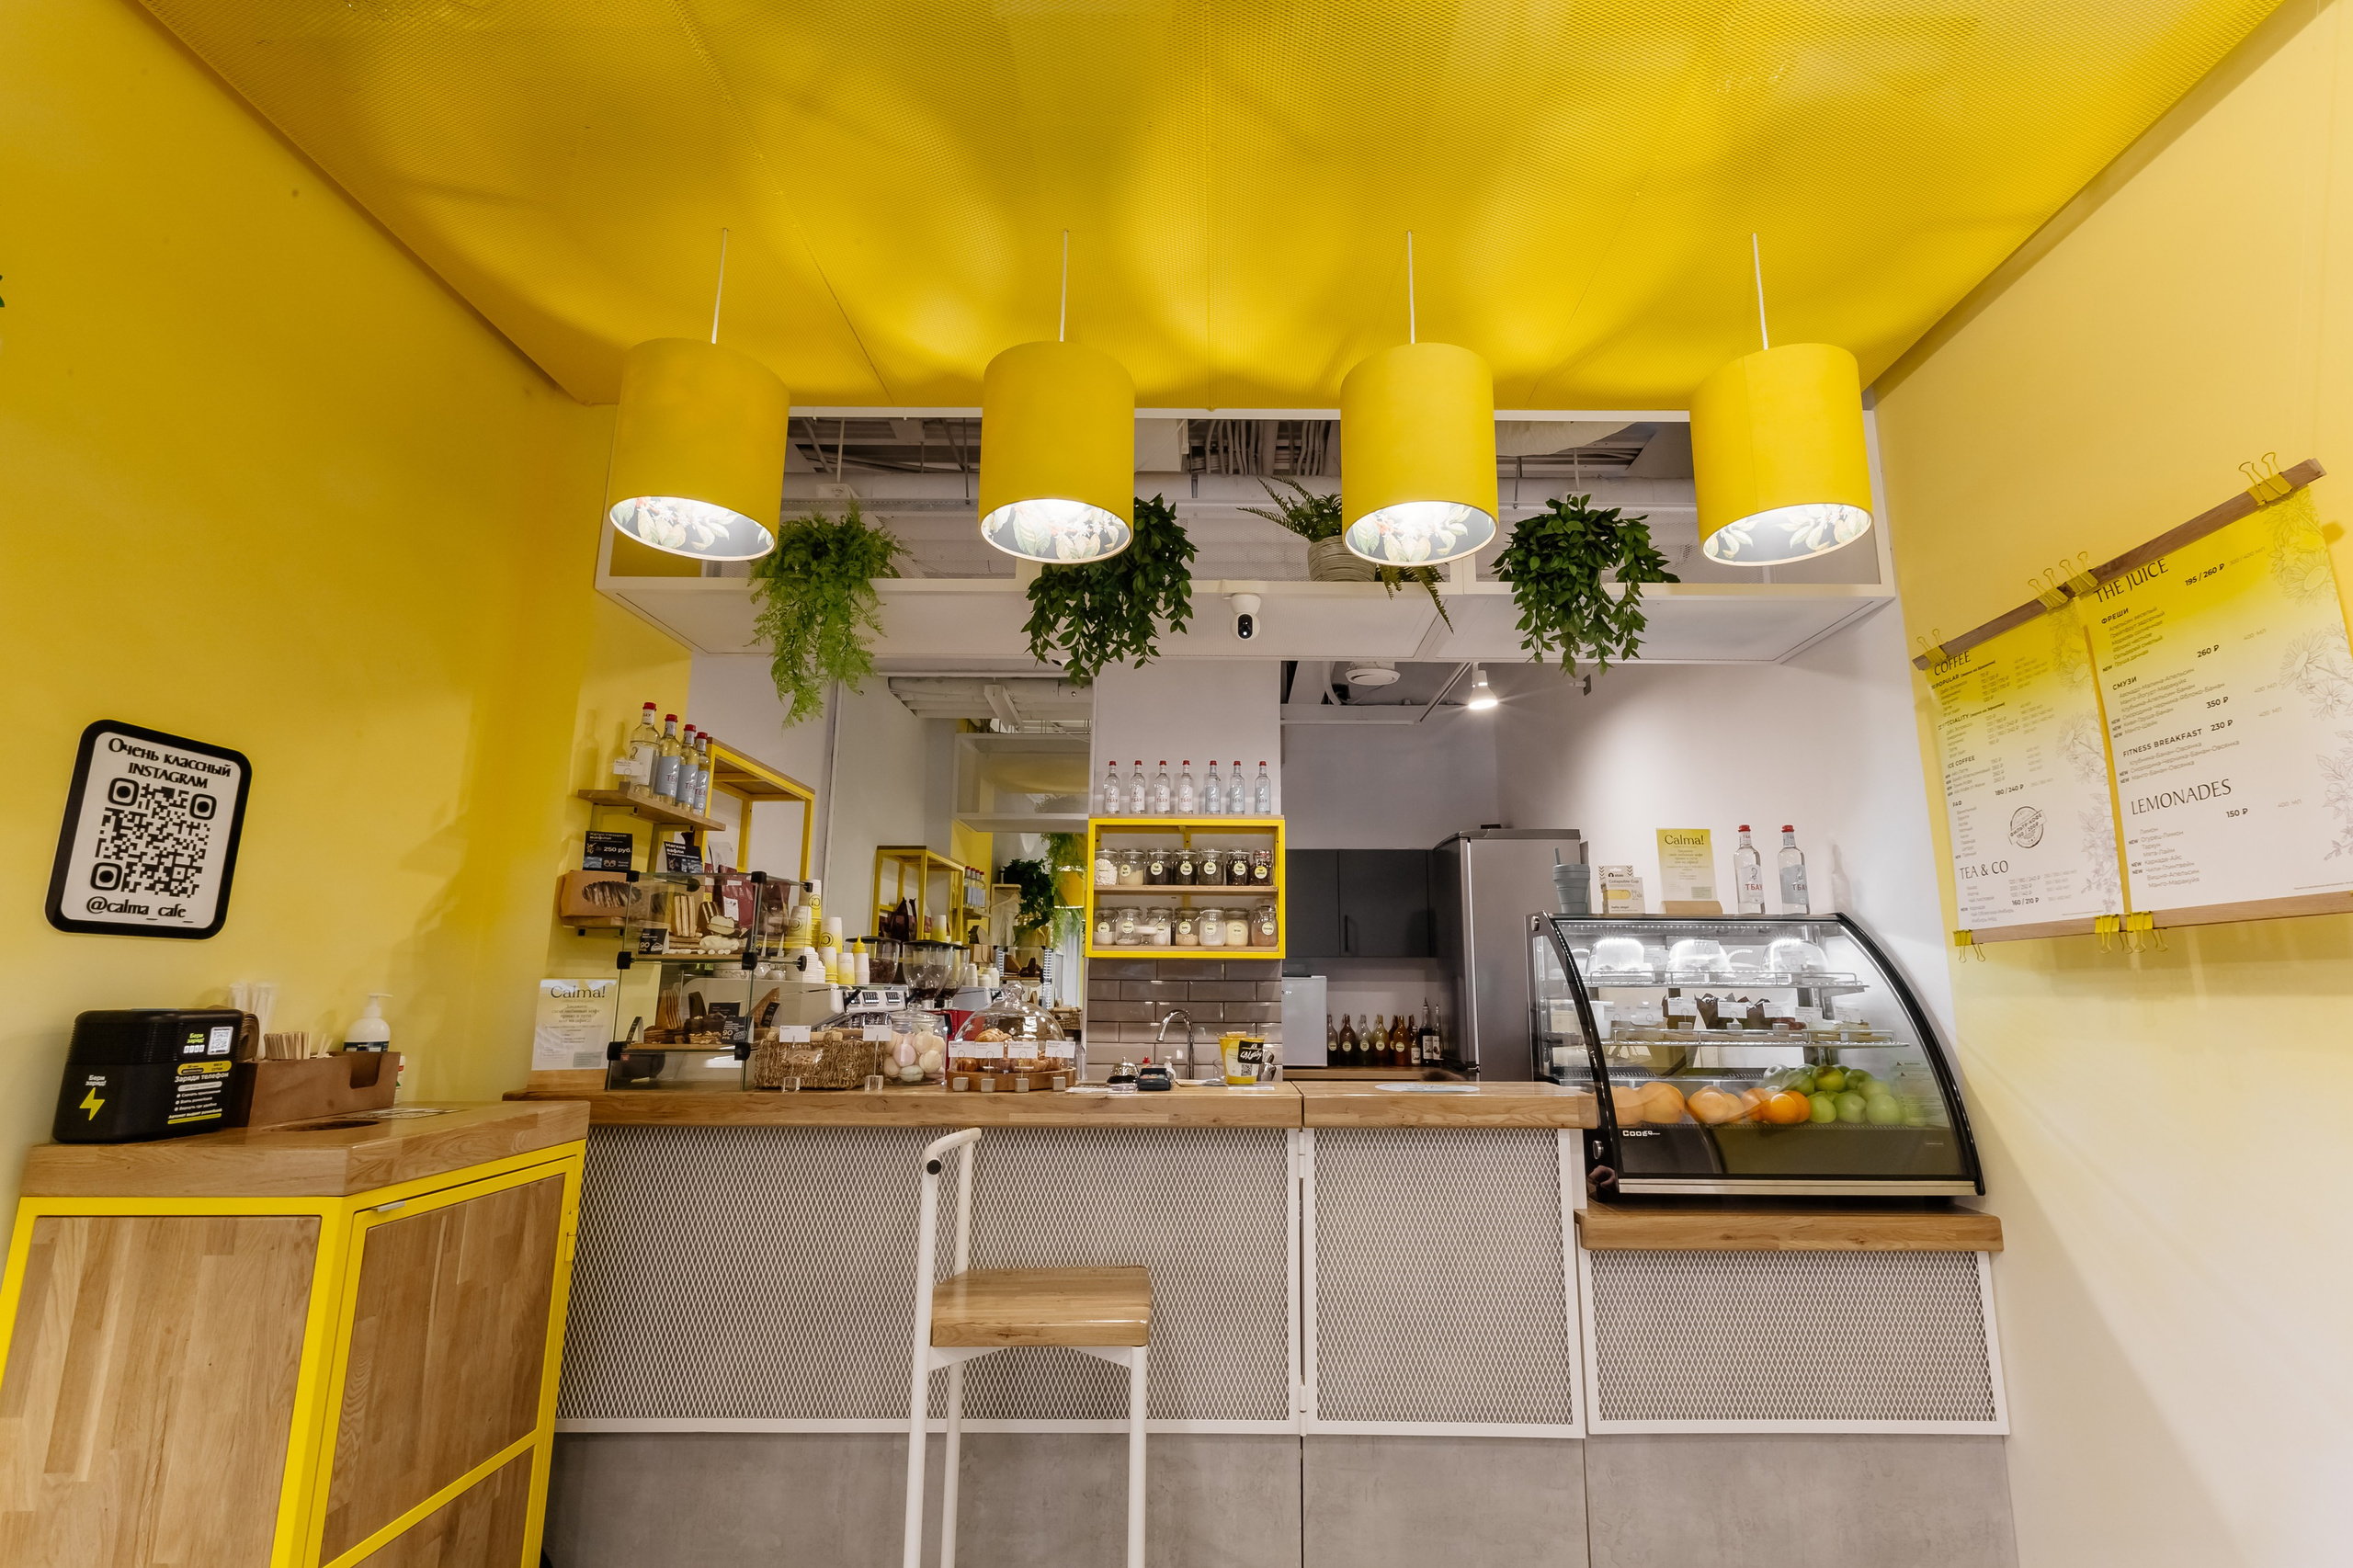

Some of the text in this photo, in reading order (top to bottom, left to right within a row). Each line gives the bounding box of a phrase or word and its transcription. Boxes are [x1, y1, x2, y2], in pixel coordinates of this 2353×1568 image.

[2093, 580, 2125, 603] THE
[2125, 557, 2169, 592] JUICE
[2184, 575, 2198, 586] 195
[2202, 567, 2218, 579] 260
[2101, 608, 2130, 625] ФРЕШИ
[2197, 647, 2211, 658] 260
[1934, 650, 1972, 676] COFFEE
[2102, 664, 2113, 673] NEW
[2112, 676, 2138, 691] СМУЗИ
[2206, 699, 2221, 709] 350
[1941, 713, 1970, 729] ECIALITY
[2122, 744, 2152, 758] FITNESS
[2154, 728, 2202, 749] BREAKFAST
[2211, 722, 2225, 732] 230
[108, 737, 232, 778] Очень классный
[1955, 755, 1975, 767] COFFEE
[127, 762, 209, 790] INSTAGRAM
[2131, 778, 2232, 815] LEMONADES
[2226, 809, 2240, 818] 150
[1665, 834, 1705, 846] Calma!
[1959, 859, 2009, 881] TEA & CO
[551, 985, 606, 999] Calma!
